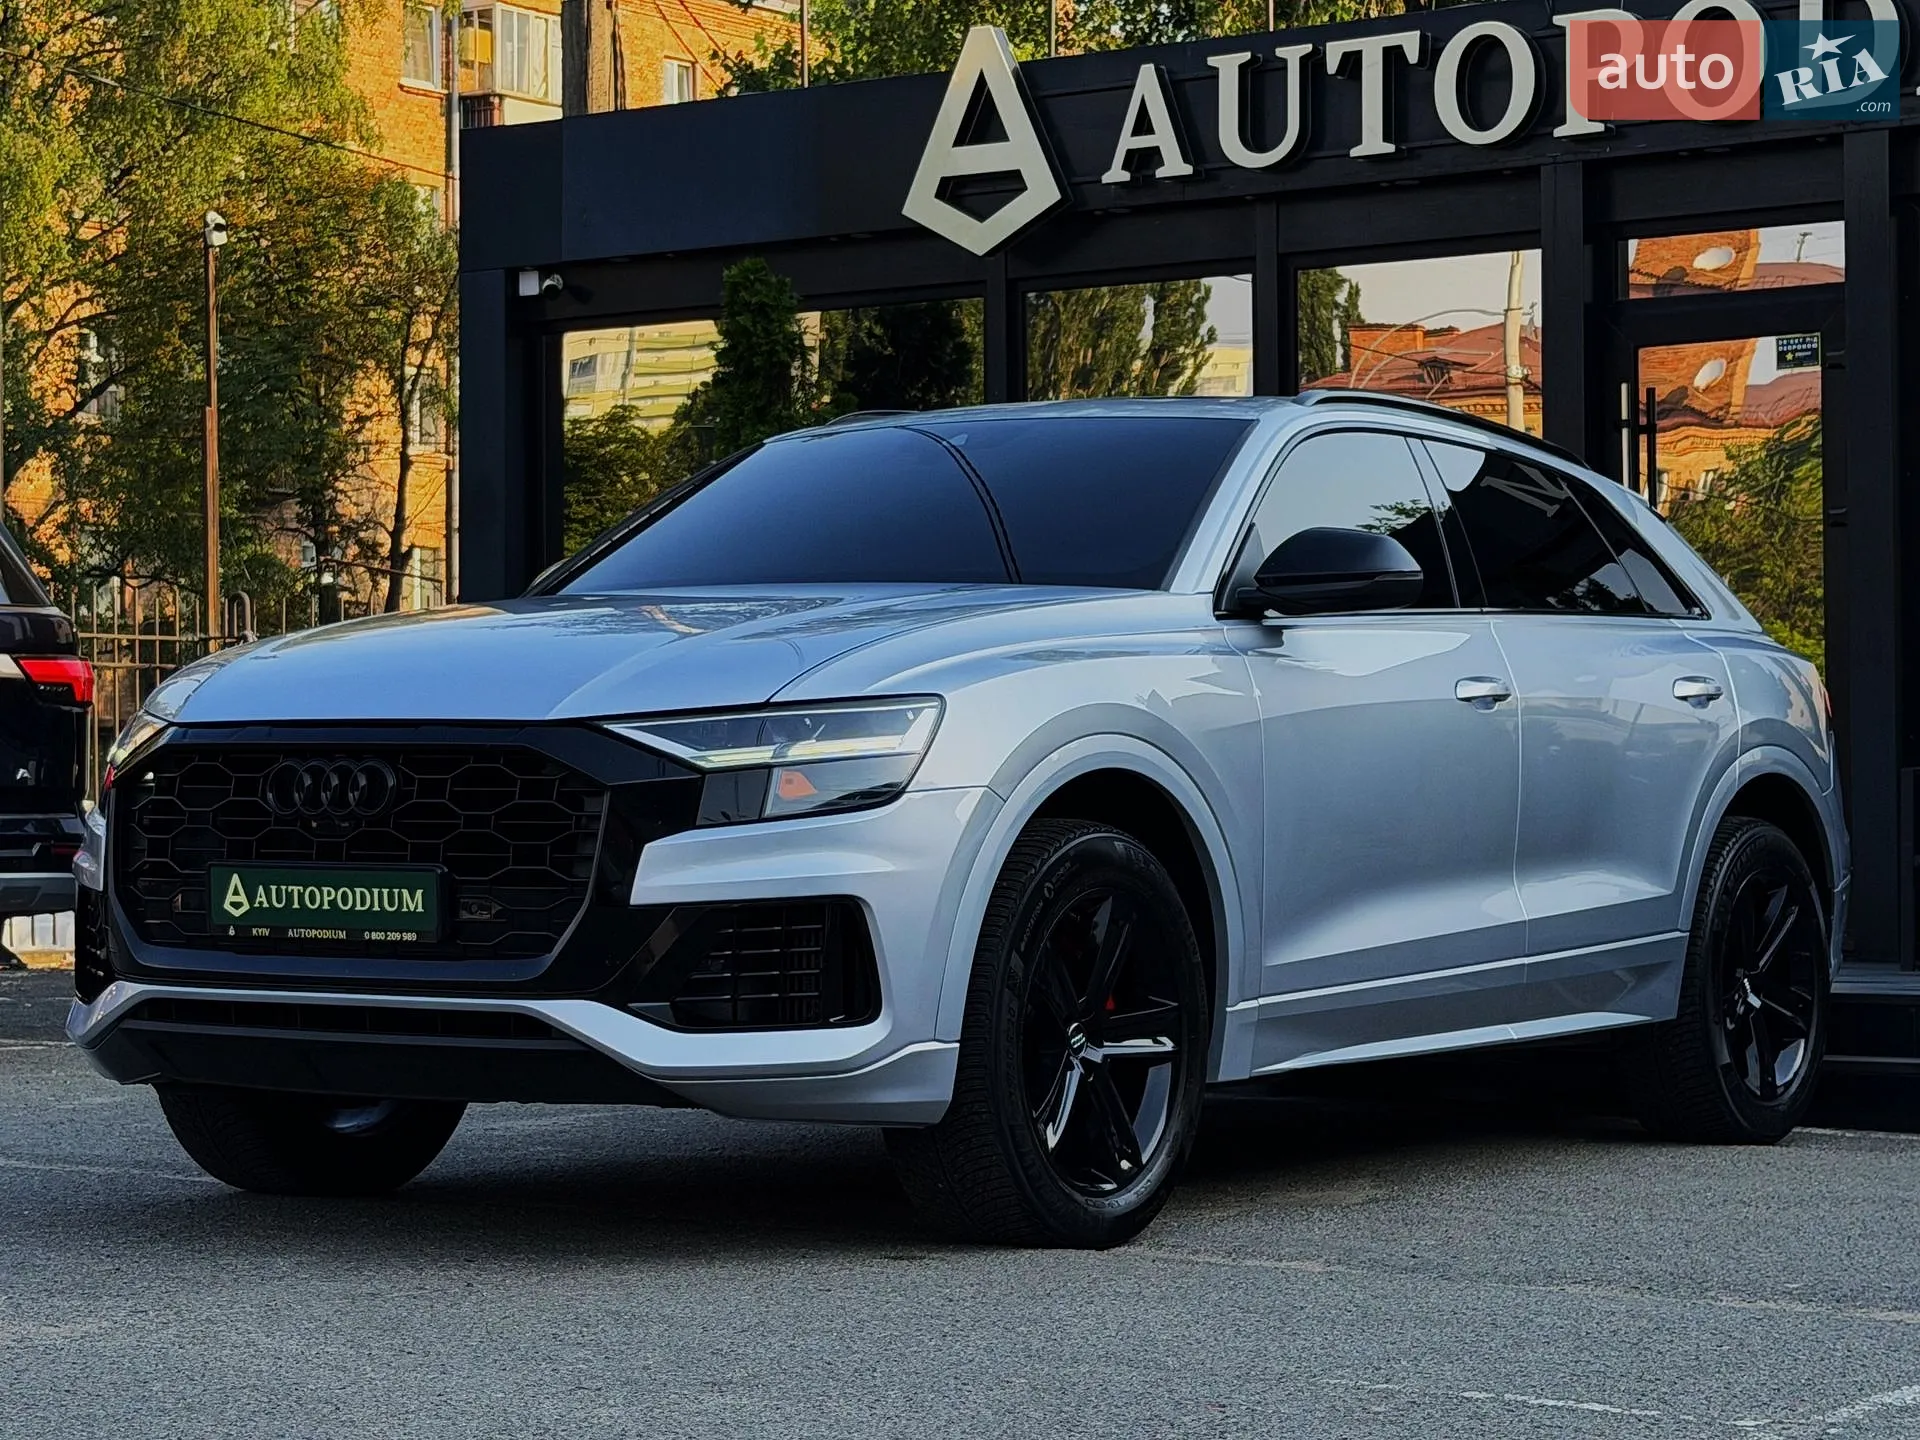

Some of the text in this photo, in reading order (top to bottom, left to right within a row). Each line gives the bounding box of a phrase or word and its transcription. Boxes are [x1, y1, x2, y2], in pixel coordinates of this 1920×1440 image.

[1101, 0, 1920, 184] AUTOPOD
[253, 885, 425, 913] AUTOPODIUM
[252, 928, 271, 937] KYIV
[287, 928, 347, 940] AUTOPODIUM
[371, 932, 386, 941] 800
[386, 932, 401, 941] 209
